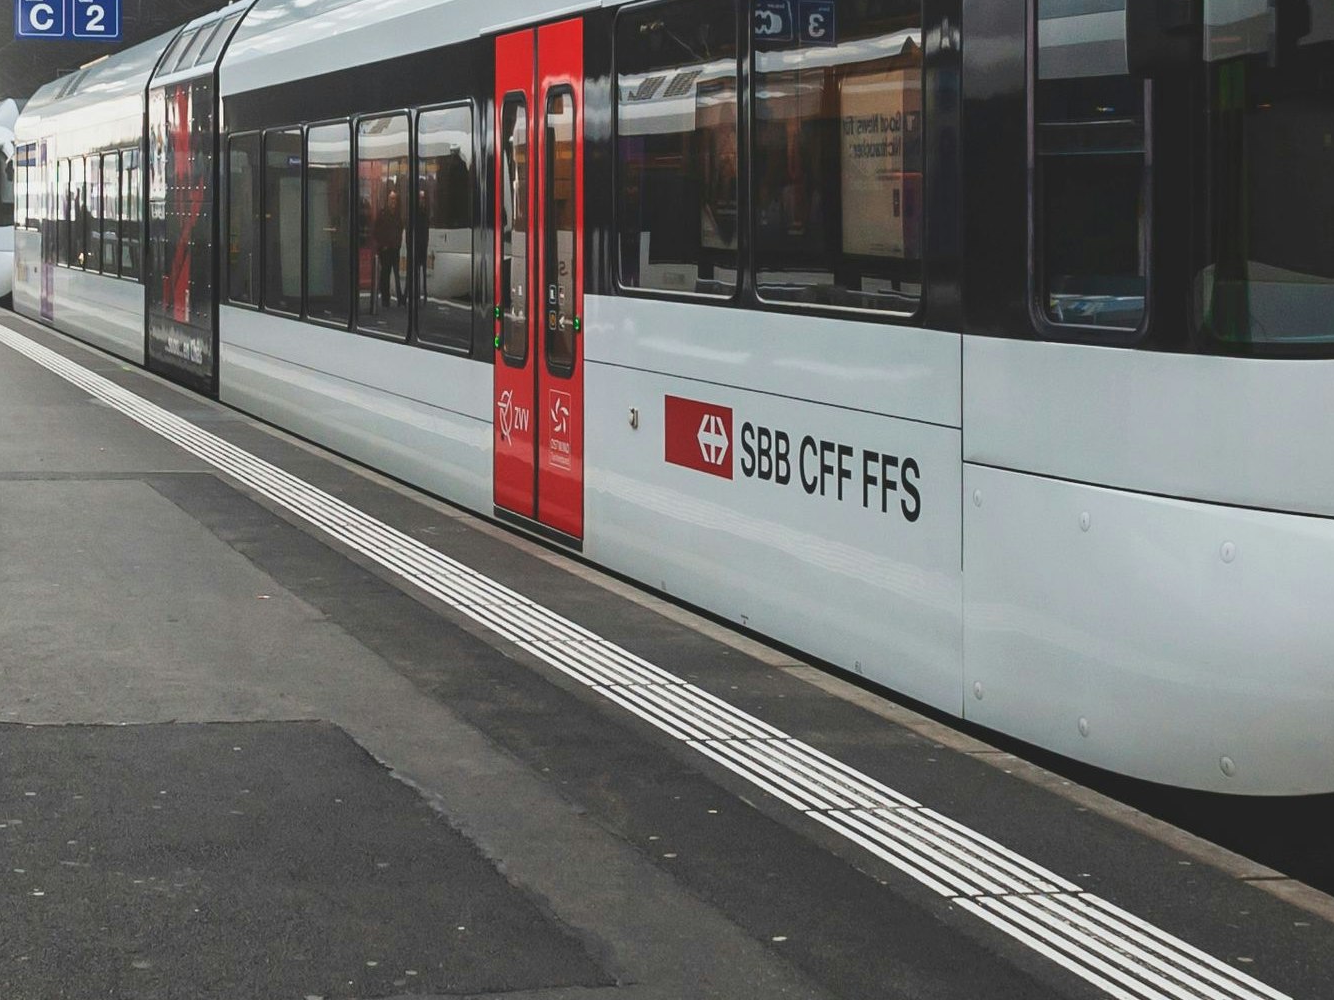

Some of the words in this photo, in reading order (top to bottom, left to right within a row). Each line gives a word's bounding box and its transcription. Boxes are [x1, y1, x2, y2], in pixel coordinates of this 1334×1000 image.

[29, 3, 54, 31] C
[85, 4, 105, 31] 2
[740, 421, 791, 486] SBB
[799, 435, 854, 501] CFF
[862, 448, 922, 523] FFS
